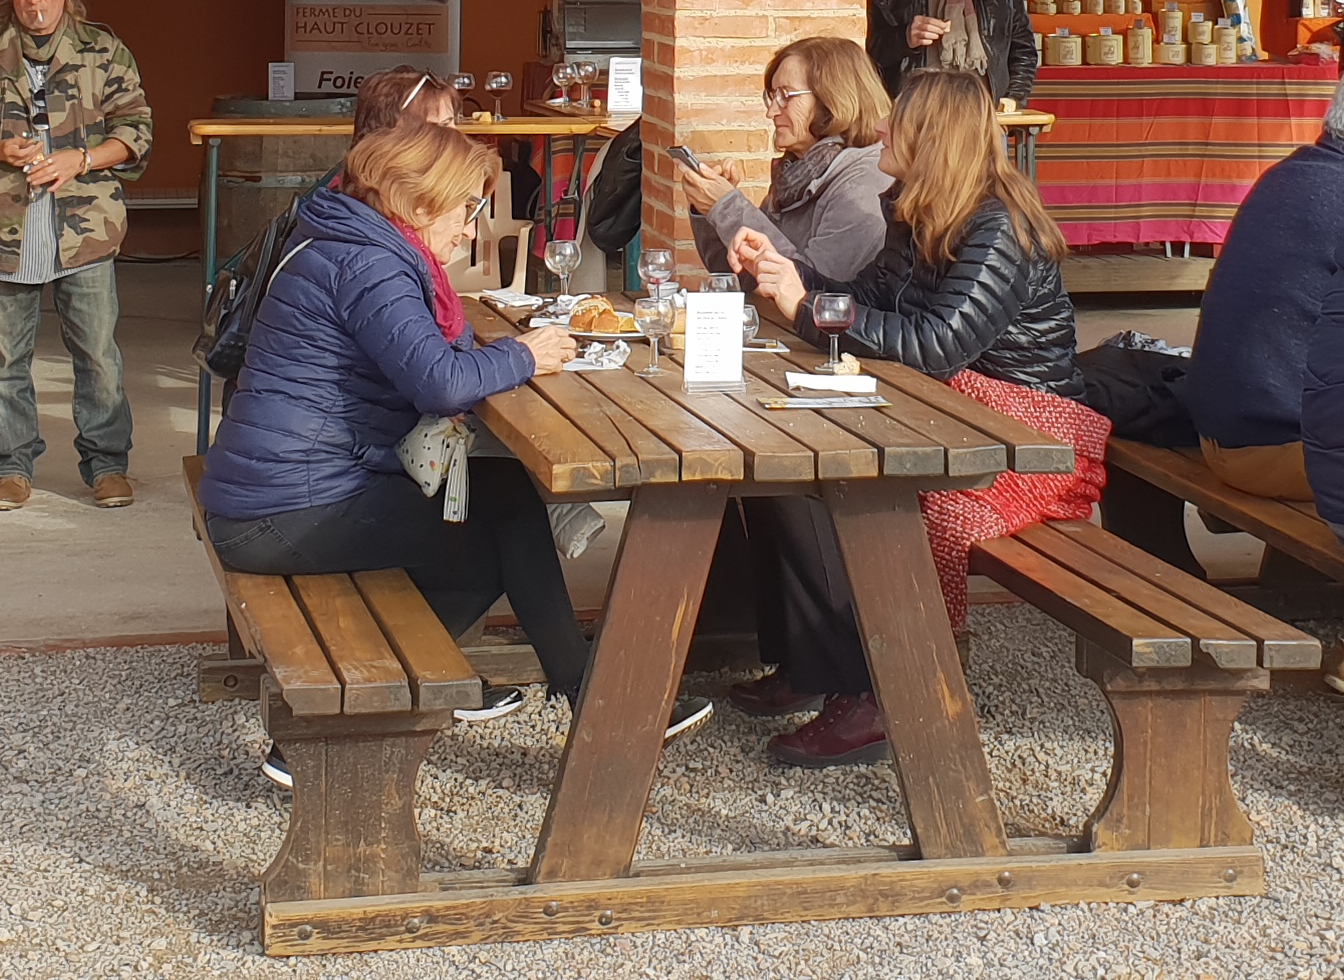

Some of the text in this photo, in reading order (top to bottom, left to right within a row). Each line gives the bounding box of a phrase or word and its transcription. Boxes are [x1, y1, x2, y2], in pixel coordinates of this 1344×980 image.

[295, 7, 363, 18] FERME DU
[295, 21, 435, 36] HAUT CLOUZET
